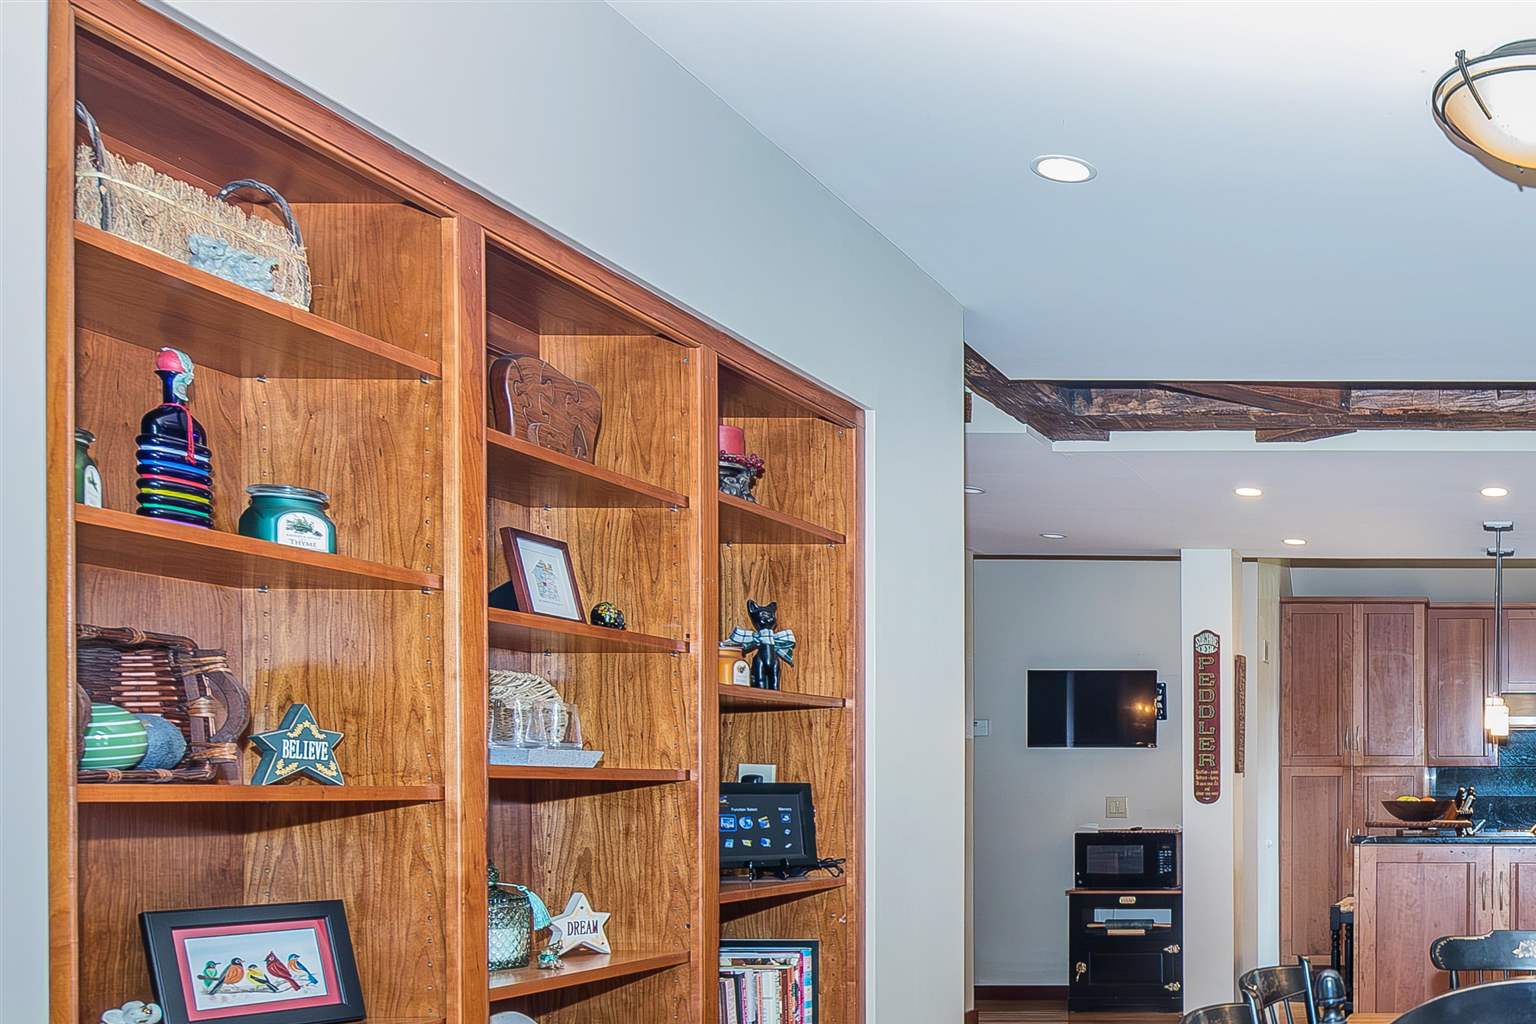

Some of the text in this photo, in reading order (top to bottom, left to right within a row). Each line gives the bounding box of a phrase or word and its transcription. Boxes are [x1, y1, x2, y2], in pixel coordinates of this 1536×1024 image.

[288, 538, 317, 548] THYME
[1198, 656, 1217, 767] PEDDLER
[282, 738, 329, 761] BELIEVE
[567, 920, 599, 936] DREAM
